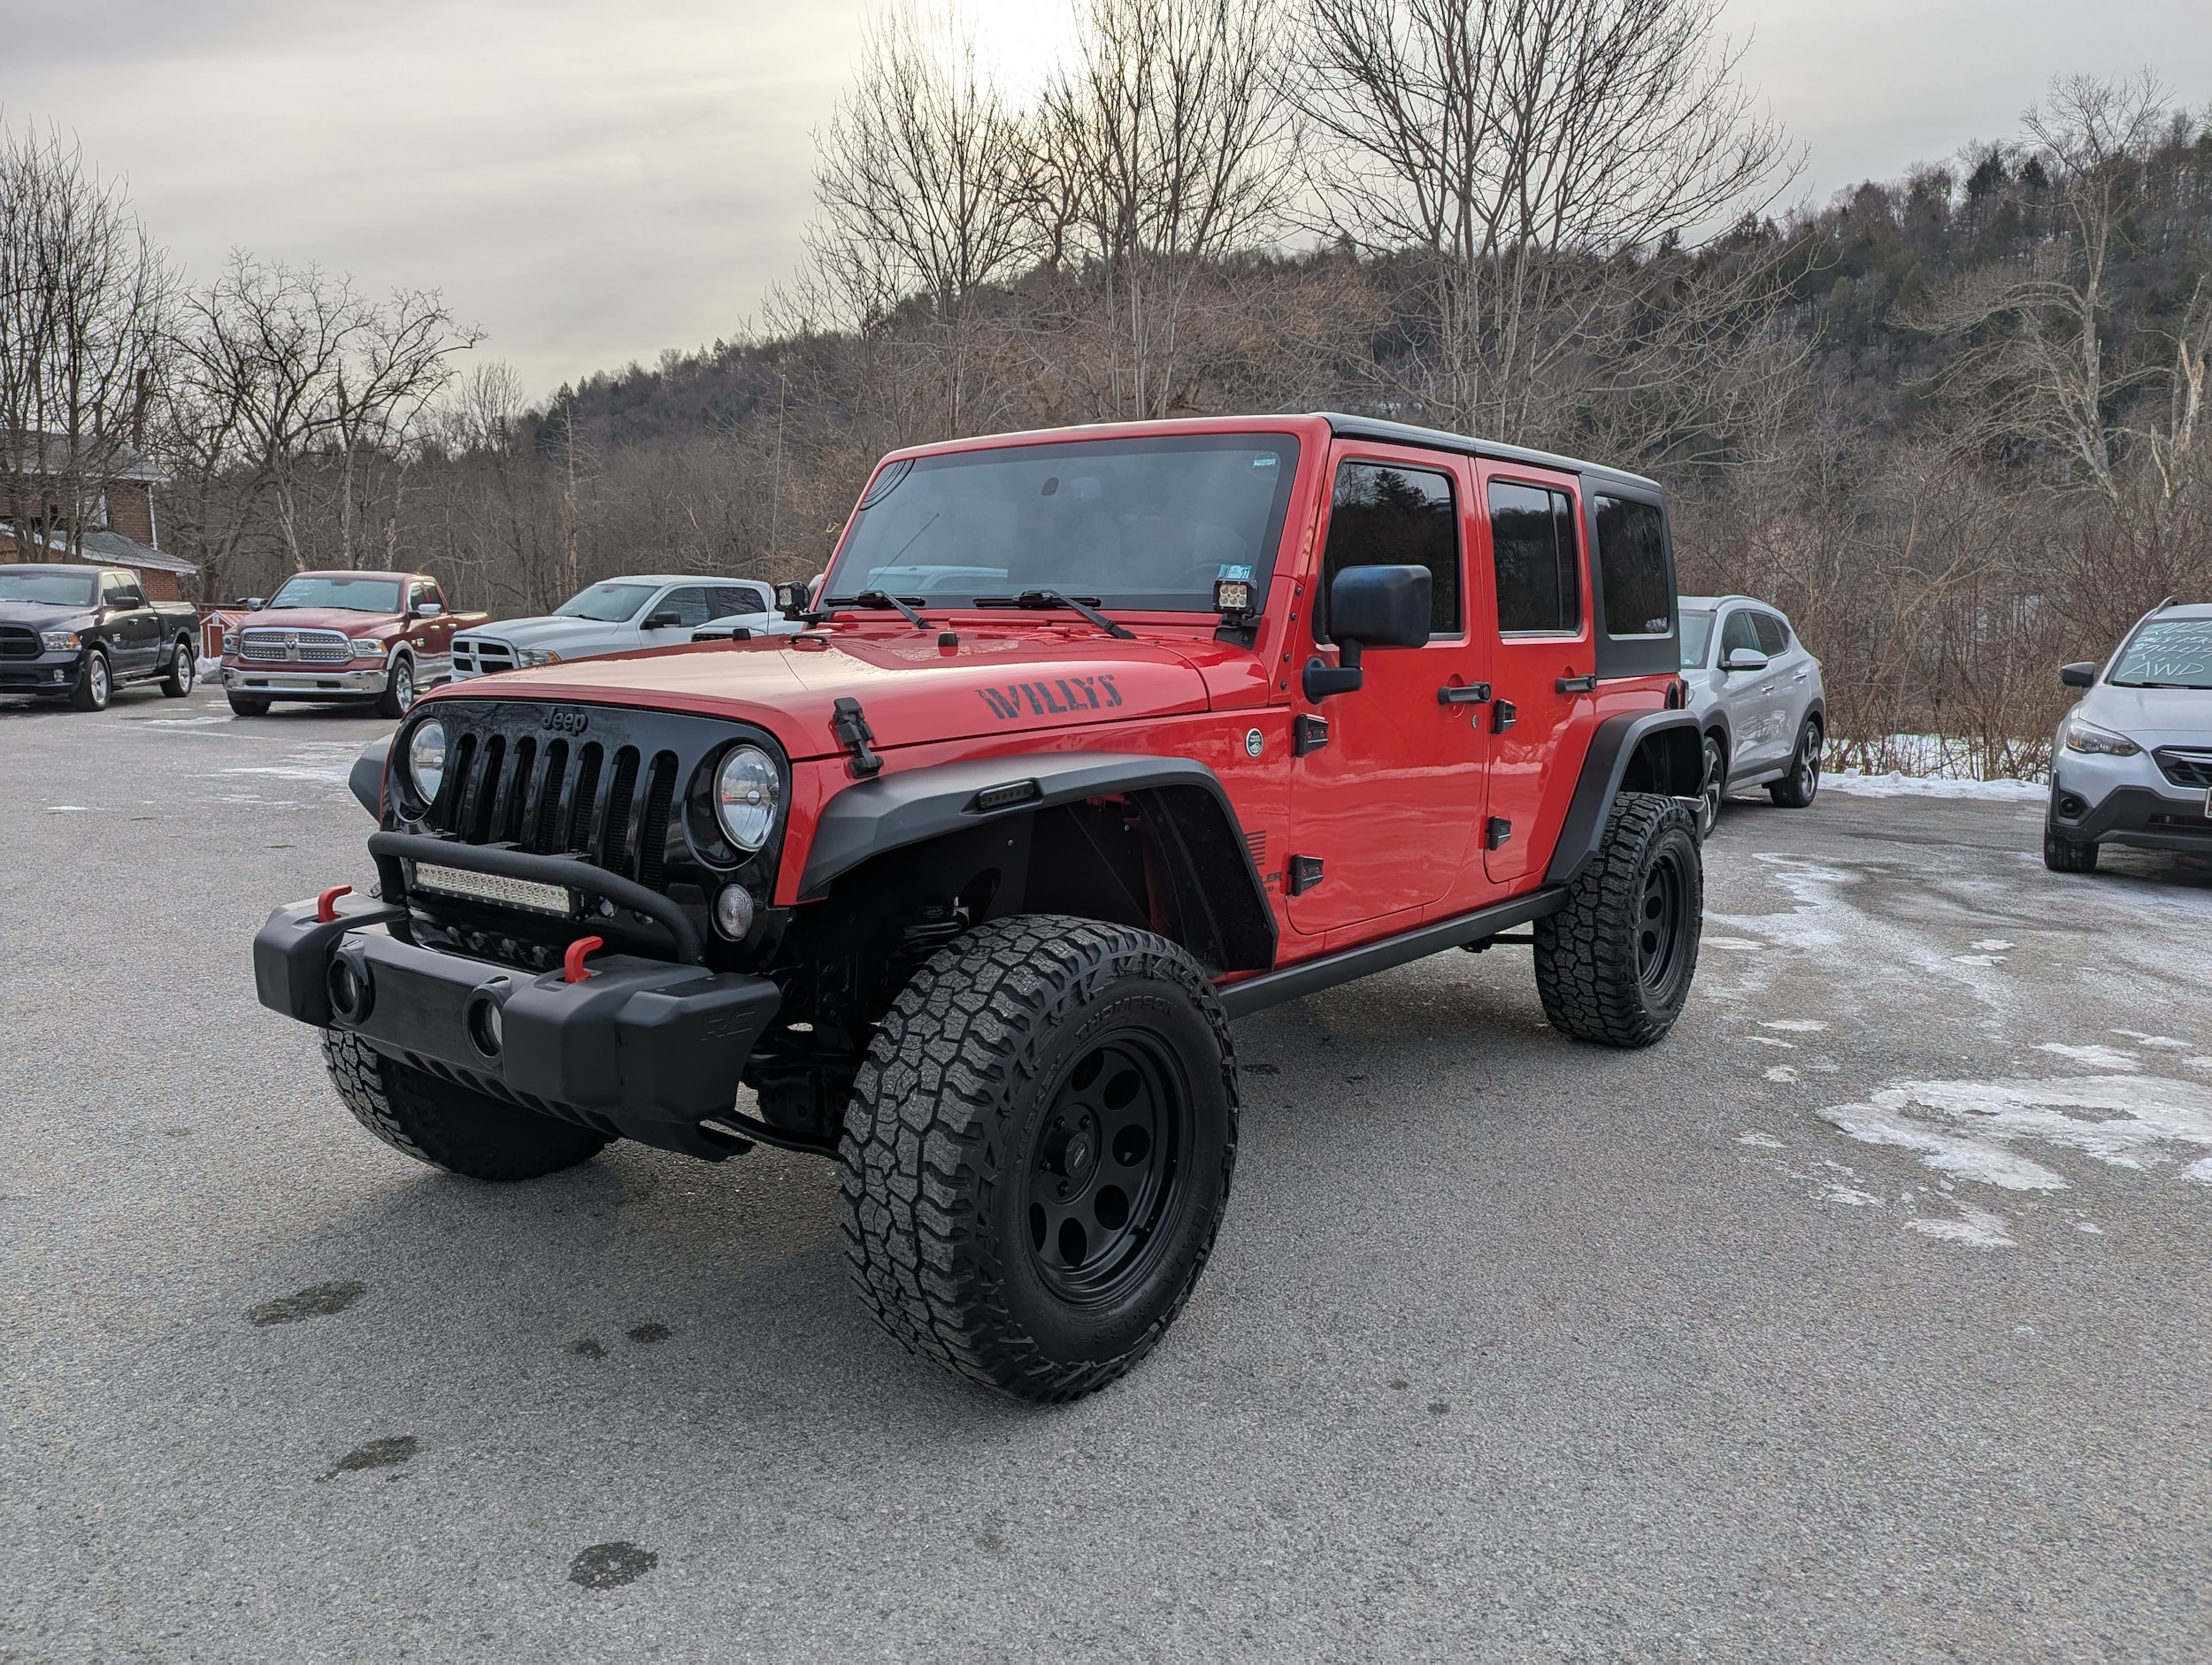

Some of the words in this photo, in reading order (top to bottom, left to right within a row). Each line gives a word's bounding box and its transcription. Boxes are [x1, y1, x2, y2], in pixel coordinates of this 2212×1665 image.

[2142, 621, 2212, 634] 202
[2121, 661, 2204, 677] AWD
[974, 674, 1123, 719] WILLYS
[541, 707, 588, 736] Jeep
